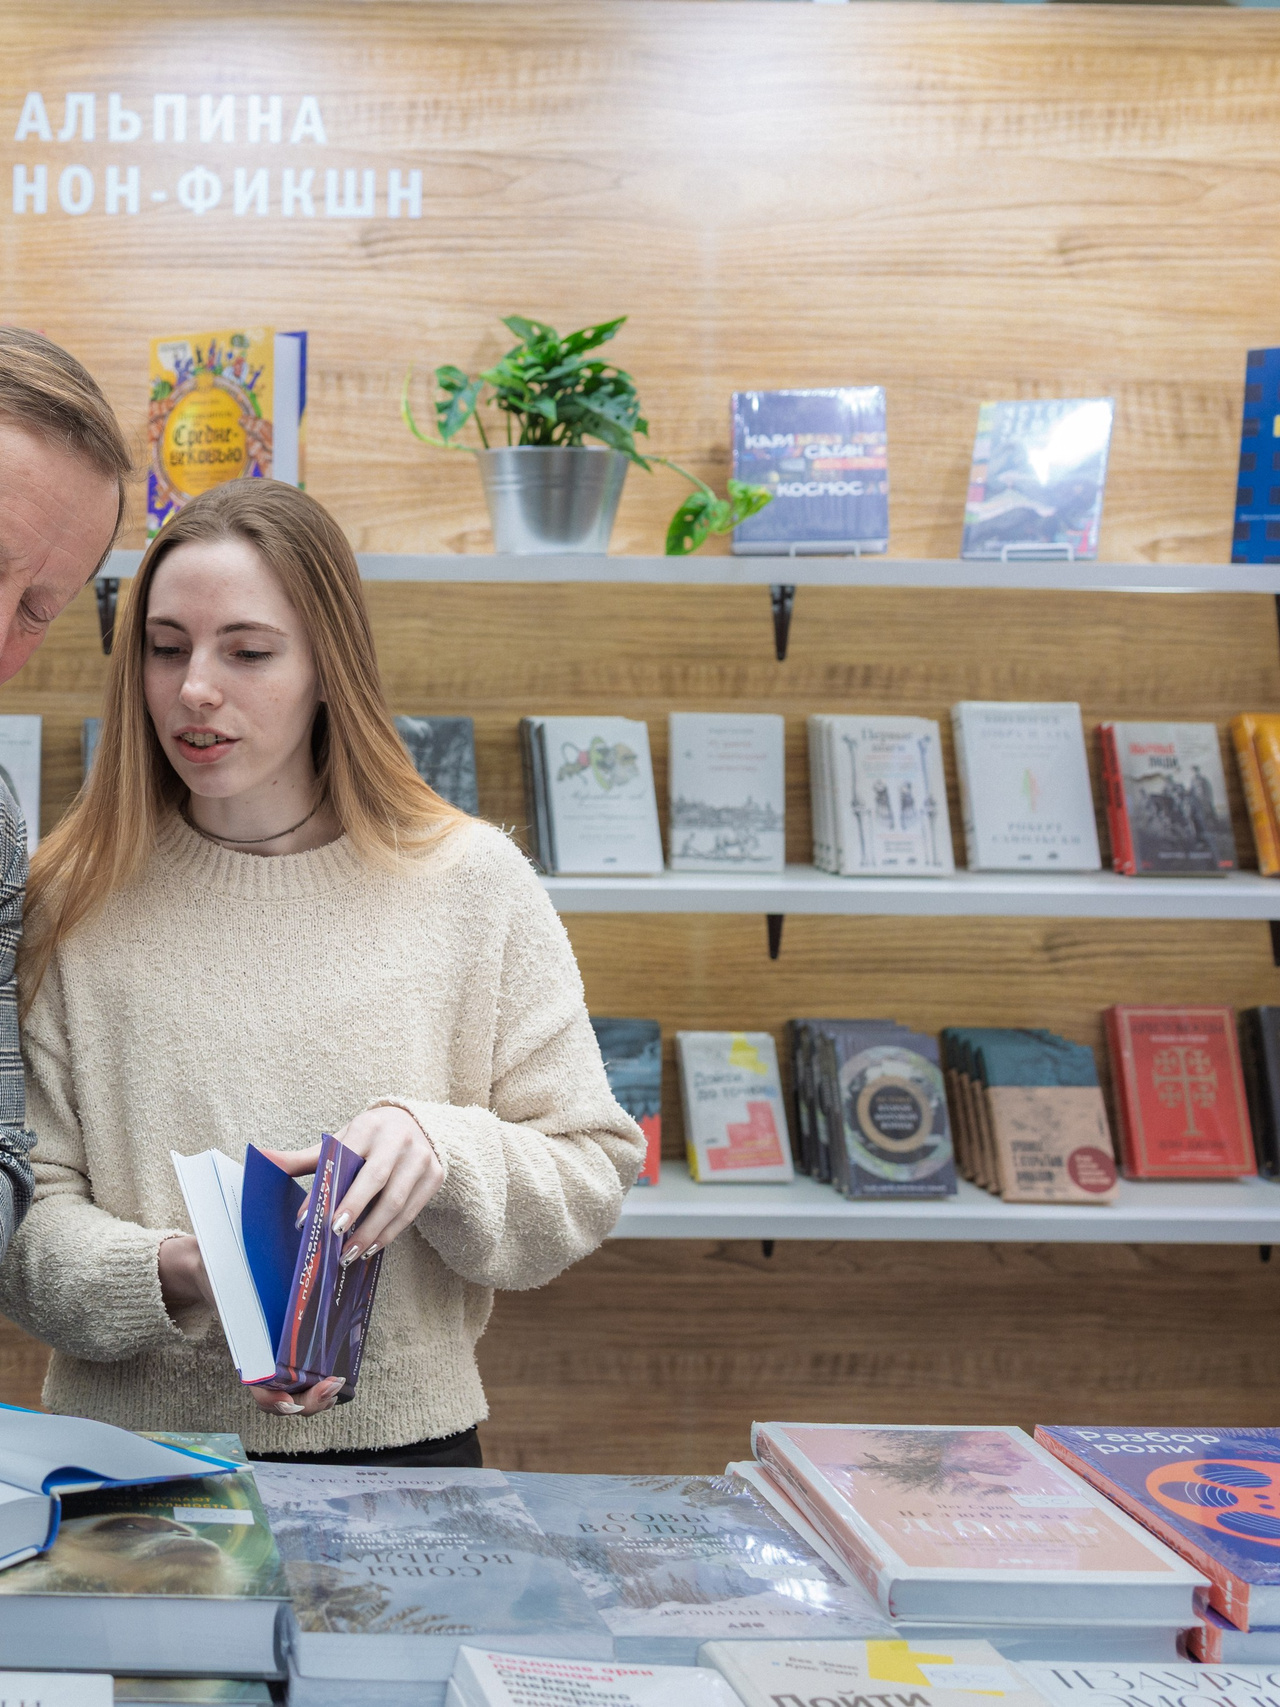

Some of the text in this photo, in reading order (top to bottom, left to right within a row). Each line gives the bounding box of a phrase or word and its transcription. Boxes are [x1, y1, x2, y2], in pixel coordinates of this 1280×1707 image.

[13, 91, 328, 144] АЛЬПИНА
[13, 163, 424, 219] НОН-ФИКШН
[745, 433, 794, 449] КАРЛ
[804, 443, 864, 459] САГАН
[776, 480, 864, 498] КОСМОС
[335, 1266, 348, 1307] Андр
[1076, 1430, 1221, 1446] Разбор
[1092, 1444, 1195, 1455] роли
[139, 1501, 229, 1510] РЕАЛЬНОСТЬ
[605, 1511, 712, 1524] СОВЫ
[577, 1522, 627, 1535] ВО
[320, 1551, 515, 1565] ВО ЛЬДАХ
[367, 1565, 483, 1578] СОВЫ
[659, 1609, 761, 1618] ДЖОНАТАН
[487, 1653, 655, 1677] Создание арки
[493, 1662, 615, 1683] персонажа
[497, 1669, 592, 1689] Секреты
[502, 1679, 631, 1701] сценарного
